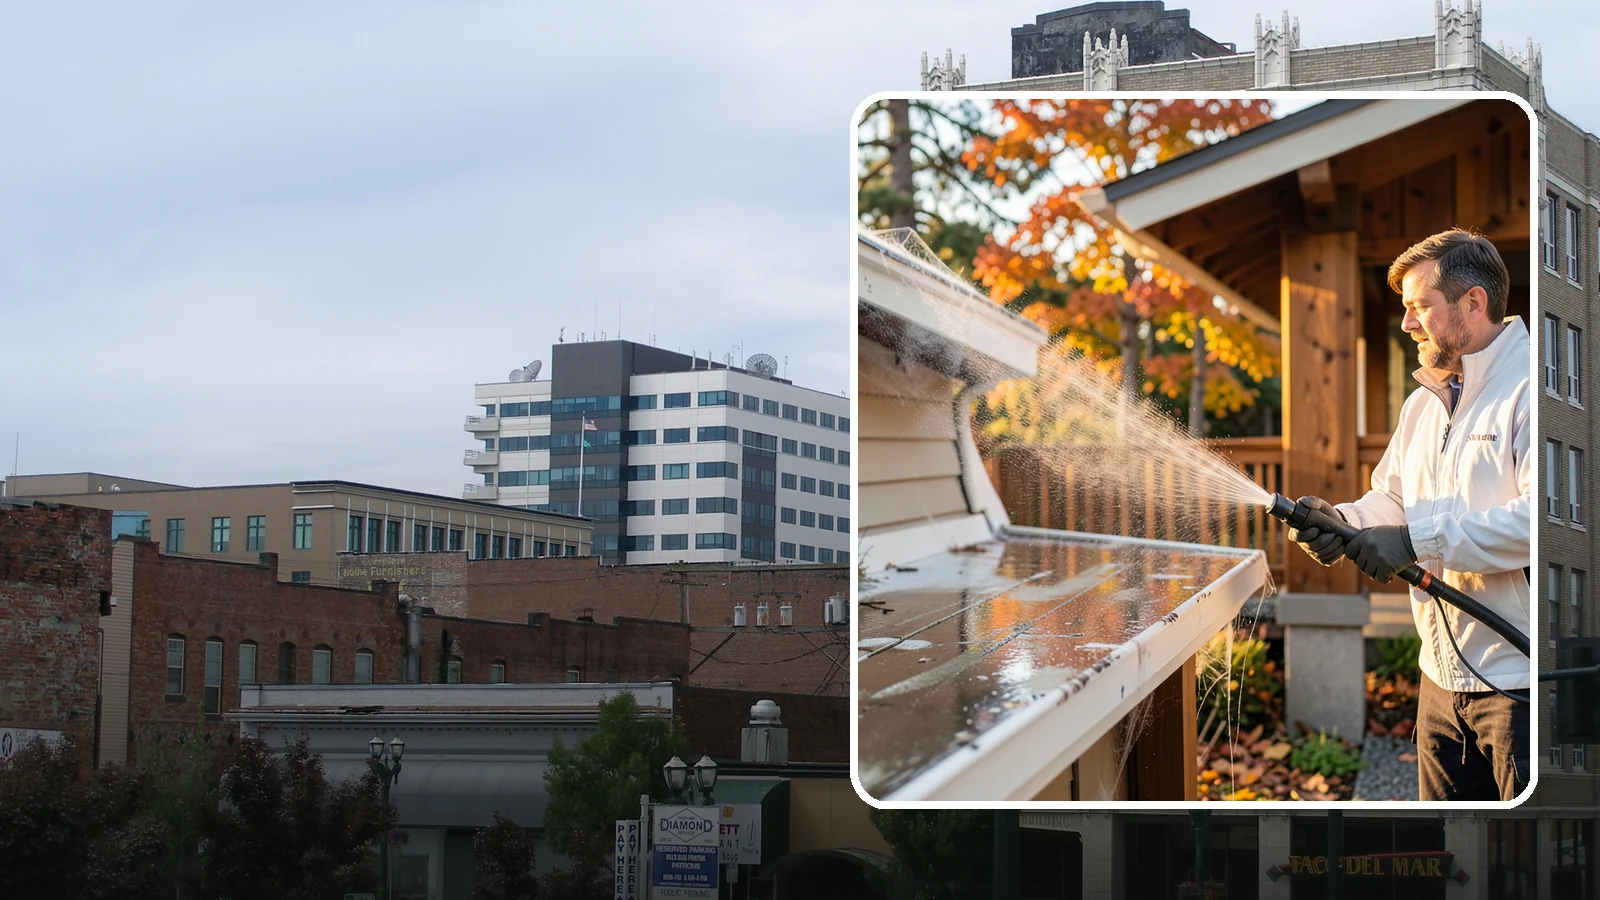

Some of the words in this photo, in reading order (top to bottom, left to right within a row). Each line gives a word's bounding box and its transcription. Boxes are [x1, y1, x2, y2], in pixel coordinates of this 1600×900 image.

[343, 568, 367, 577] Home
[370, 566, 426, 577] Furnishers
[660, 818, 713, 833] DIAMOND
[1022, 815, 1070, 828] BUILDING
[617, 825, 625, 852] PAY
[628, 824, 637, 852] PAY
[656, 845, 688, 853] RESERVED
[689, 846, 716, 854] PARKING
[721, 851, 739, 862] Soup
[671, 862, 701, 870] PATRONS
[1289, 855, 1329, 875] TAC
[1346, 856, 1384, 876] DEL
[1392, 857, 1443, 877] MAR
[616, 856, 625, 893] HERE
[627, 856, 636, 893] HERE
[660, 888, 682, 897] PUBLIC
[683, 889, 710, 898] PARKING
